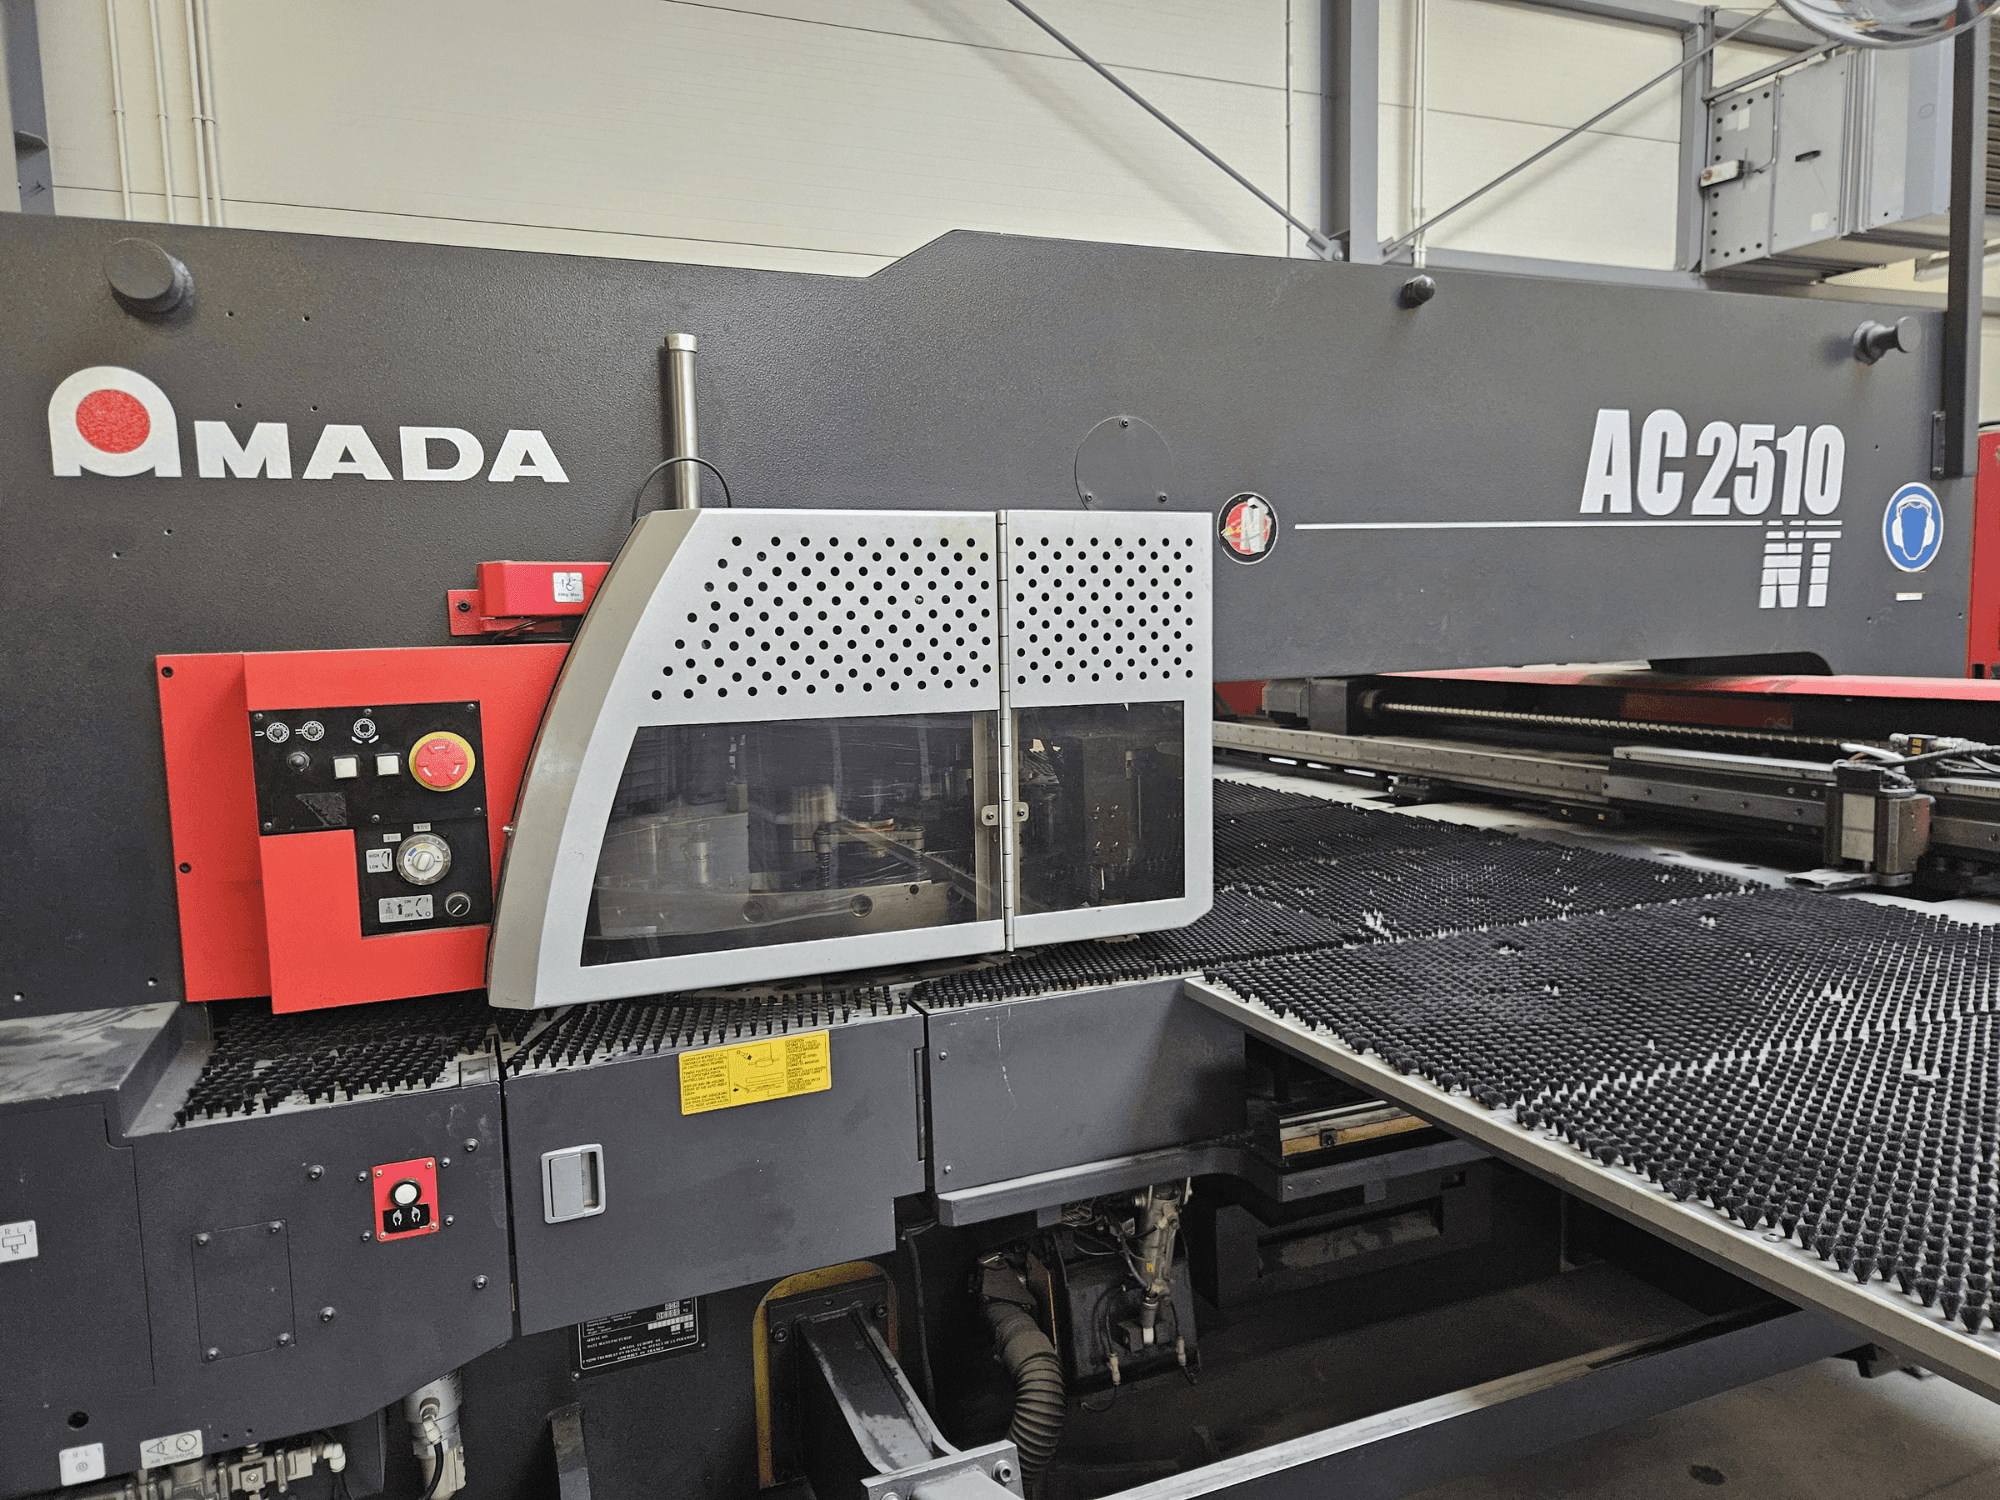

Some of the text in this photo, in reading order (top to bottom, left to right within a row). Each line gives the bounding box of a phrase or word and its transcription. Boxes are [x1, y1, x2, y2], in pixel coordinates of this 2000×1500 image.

[48, 366, 569, 482] AMADA
[1580, 409, 1845, 515] AC 2510
[1759, 520, 1841, 608] NT
